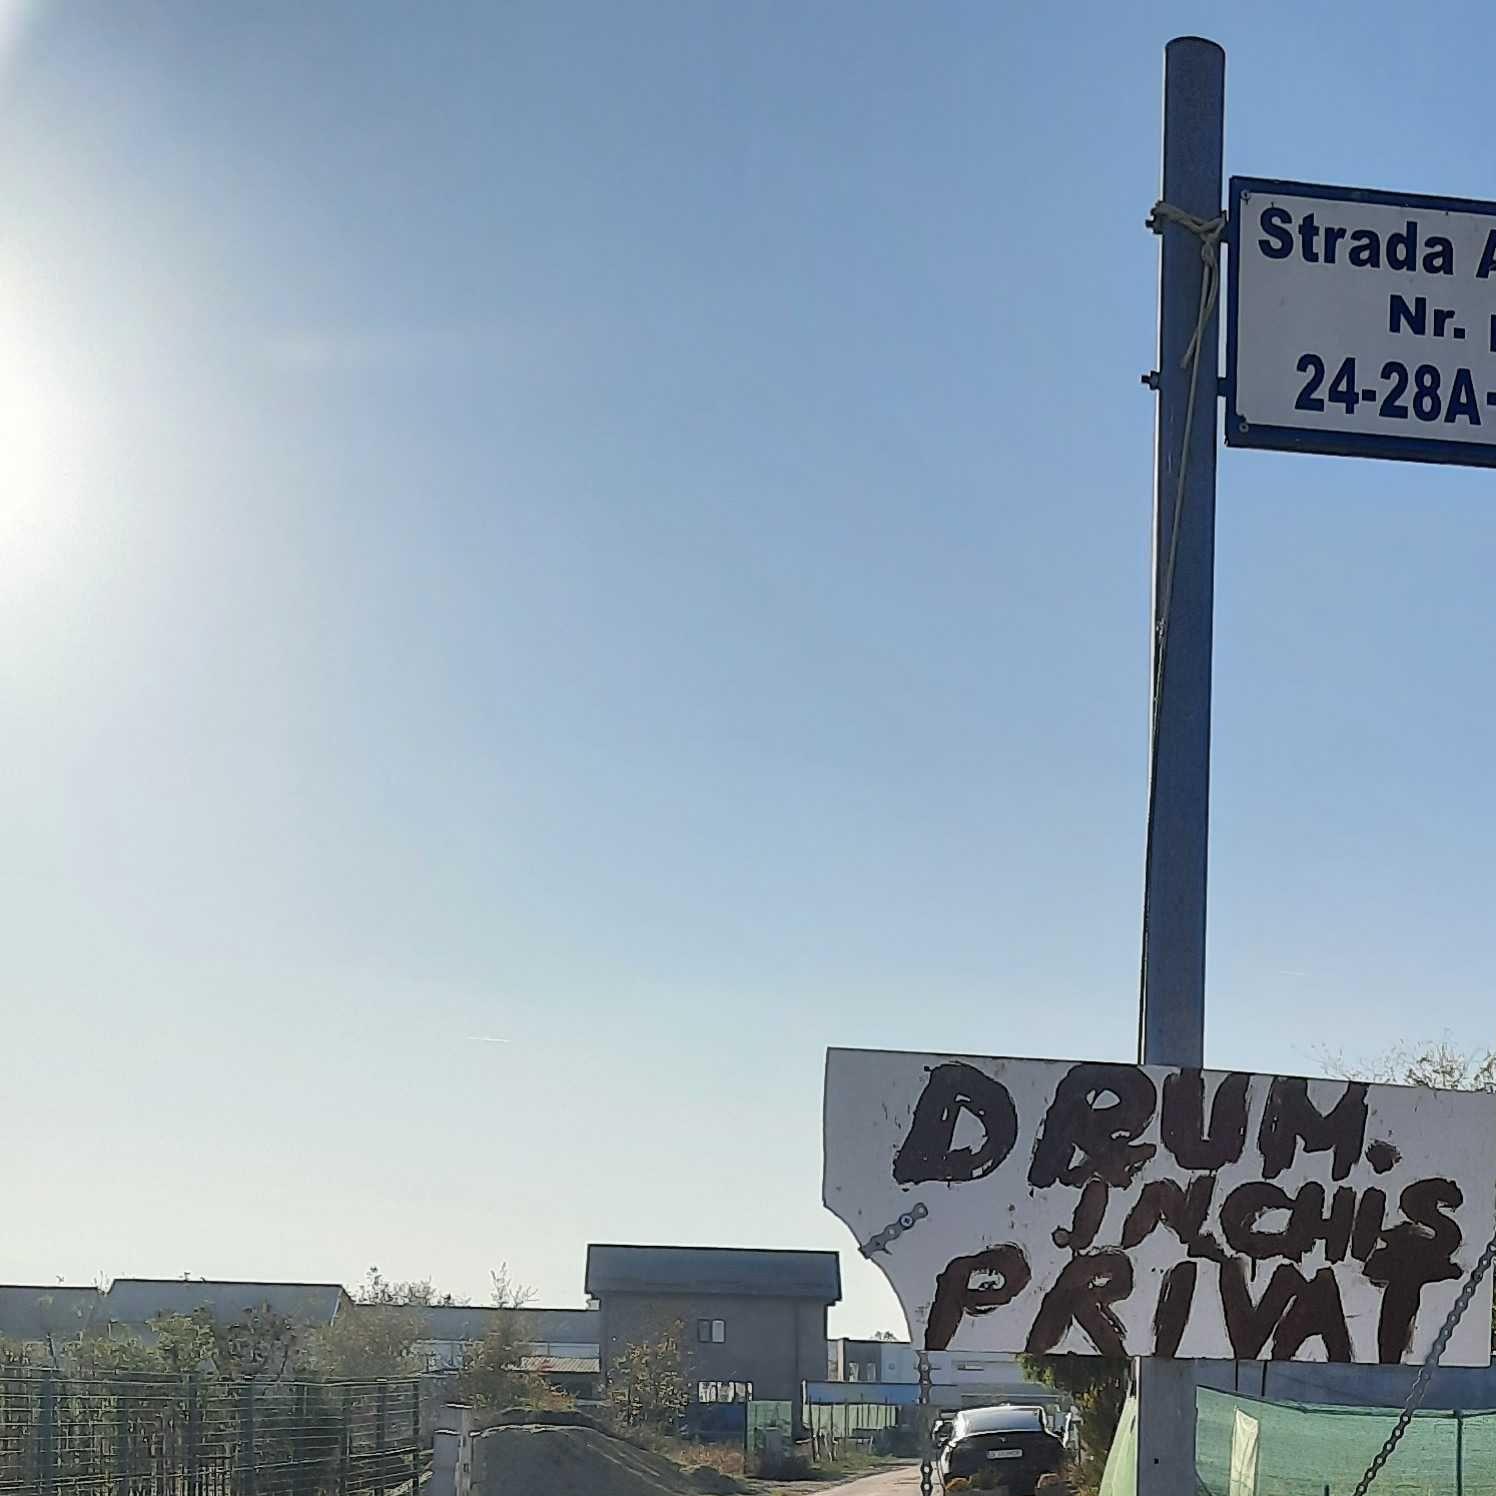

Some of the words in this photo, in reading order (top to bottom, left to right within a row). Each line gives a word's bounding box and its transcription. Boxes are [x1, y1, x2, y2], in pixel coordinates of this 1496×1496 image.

[1258, 207, 1454, 275] Strada
[1389, 294, 1466, 341] Nr.
[1294, 353, 1482, 425] 24-28A
[924, 1224, 1464, 1364] PRIVAT
